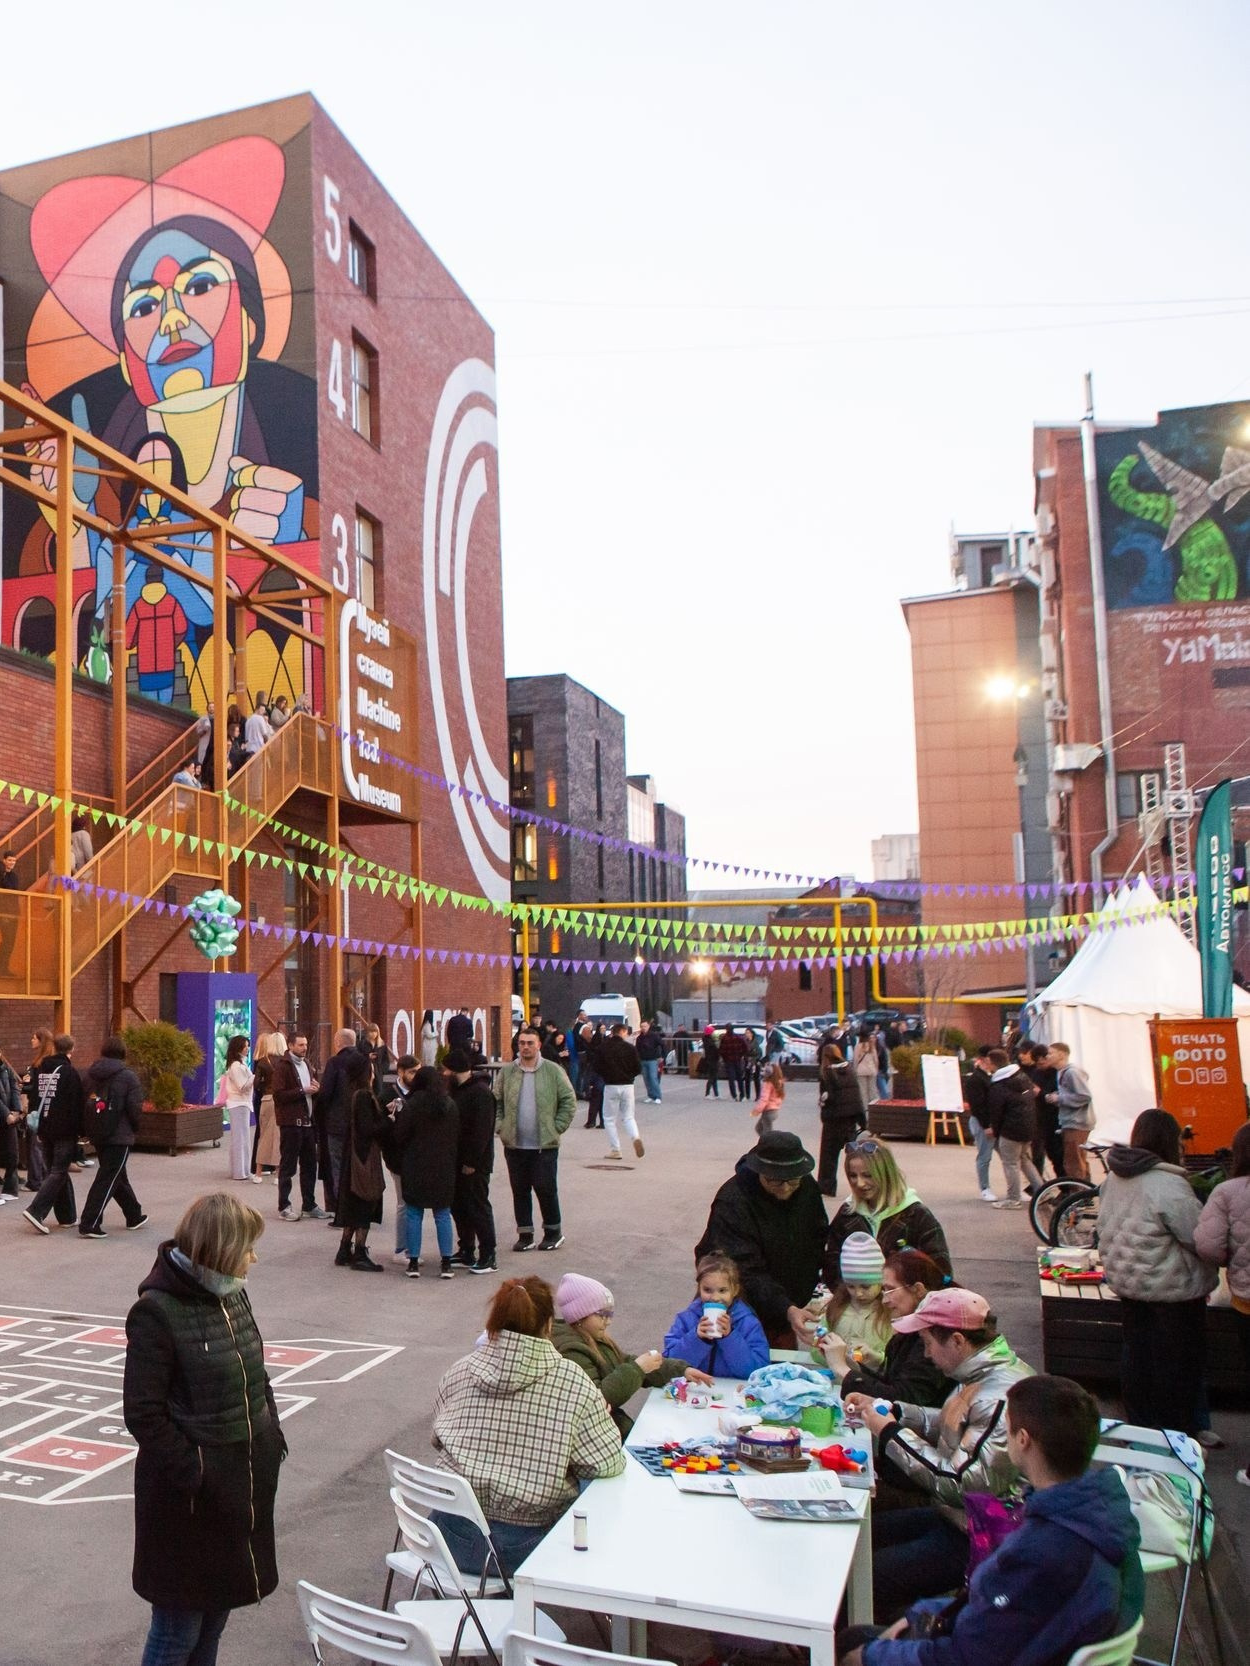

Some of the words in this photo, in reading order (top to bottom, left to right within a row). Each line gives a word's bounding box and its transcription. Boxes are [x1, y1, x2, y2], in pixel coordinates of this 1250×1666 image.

[323, 174, 342, 264] 5
[328, 338, 346, 420] 4
[331, 512, 349, 595] 3
[357, 602, 389, 647] Музей
[357, 653, 393, 689] станка
[357, 687, 401, 732] Machine
[358, 773, 401, 813] Museum
[1172, 1034, 1226, 1045] ПЕЧАТЬ
[1173, 1048, 1227, 1062] ФОТО
[54, 1393, 100, 1403] 27
[49, 1447, 97, 1460] 30
